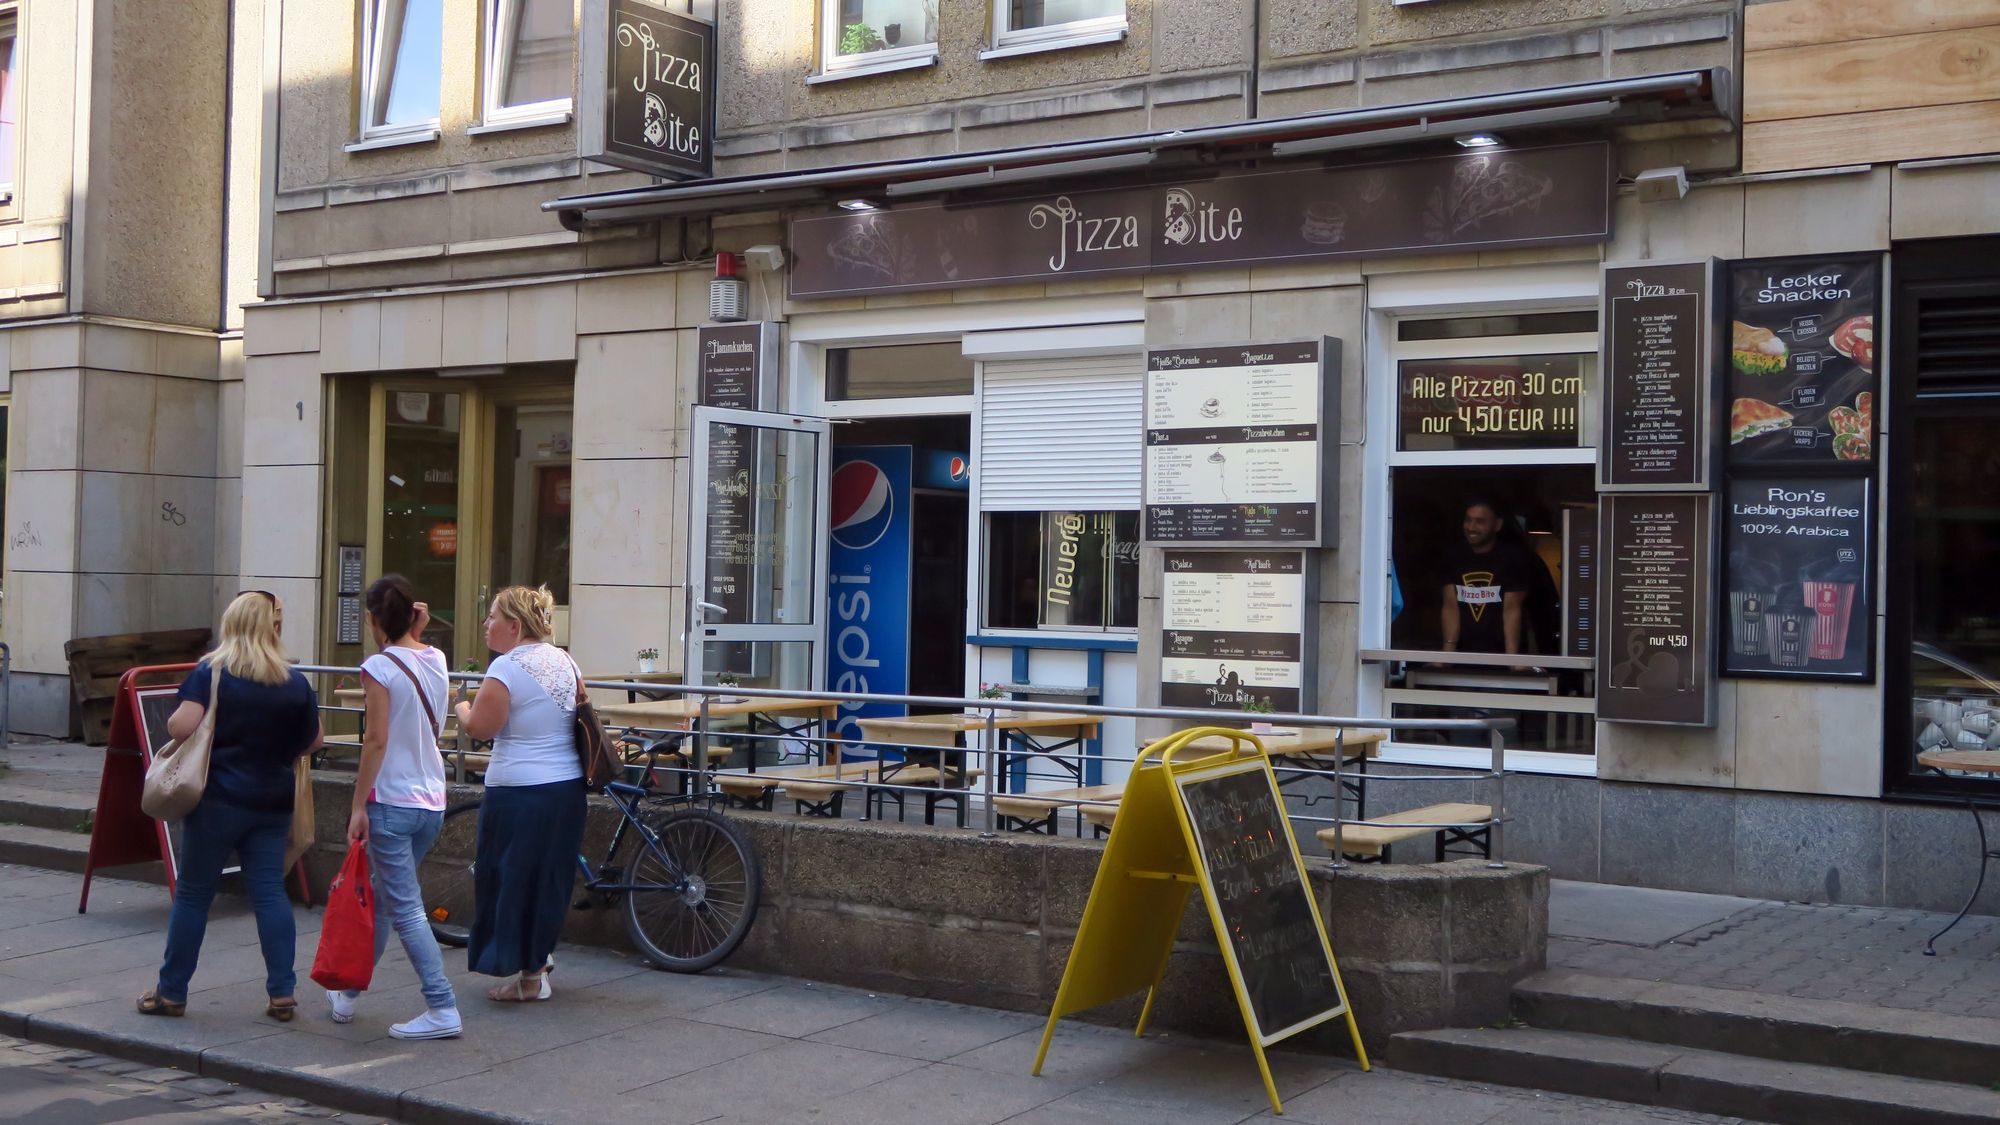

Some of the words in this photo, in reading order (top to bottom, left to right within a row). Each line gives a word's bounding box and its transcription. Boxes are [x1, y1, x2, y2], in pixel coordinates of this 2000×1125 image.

[617, 22, 700, 92] Pizza
[643, 92, 700, 155] Bite
[1029, 196, 1139, 271] Pizza
[1164, 187, 1243, 246] Bite
[1626, 278, 1665, 301] Pizza
[1767, 274, 1842, 289] Lecker
[1757, 288, 1850, 303] Snacken
[1412, 376, 1446, 399] Alle
[1451, 375, 1516, 397] Pizzen
[1521, 372, 1545, 396] 30
[1421, 416, 1453, 433] nur
[1458, 405, 1502, 436] 4,50
[1508, 408, 1544, 431] EUR
[1553, 407, 1575, 431] !!!
[1767, 487, 1826, 503] Ron's
[1733, 503, 1860, 520] Lieblingskaffee
[1740, 523, 1782, 535] 100%
[1785, 525, 1850, 537] Arabica
[1649, 636, 1666, 646] nur
[1667, 634, 1688, 647] 4,50
[1206, 687, 1234, 706] Pizza
